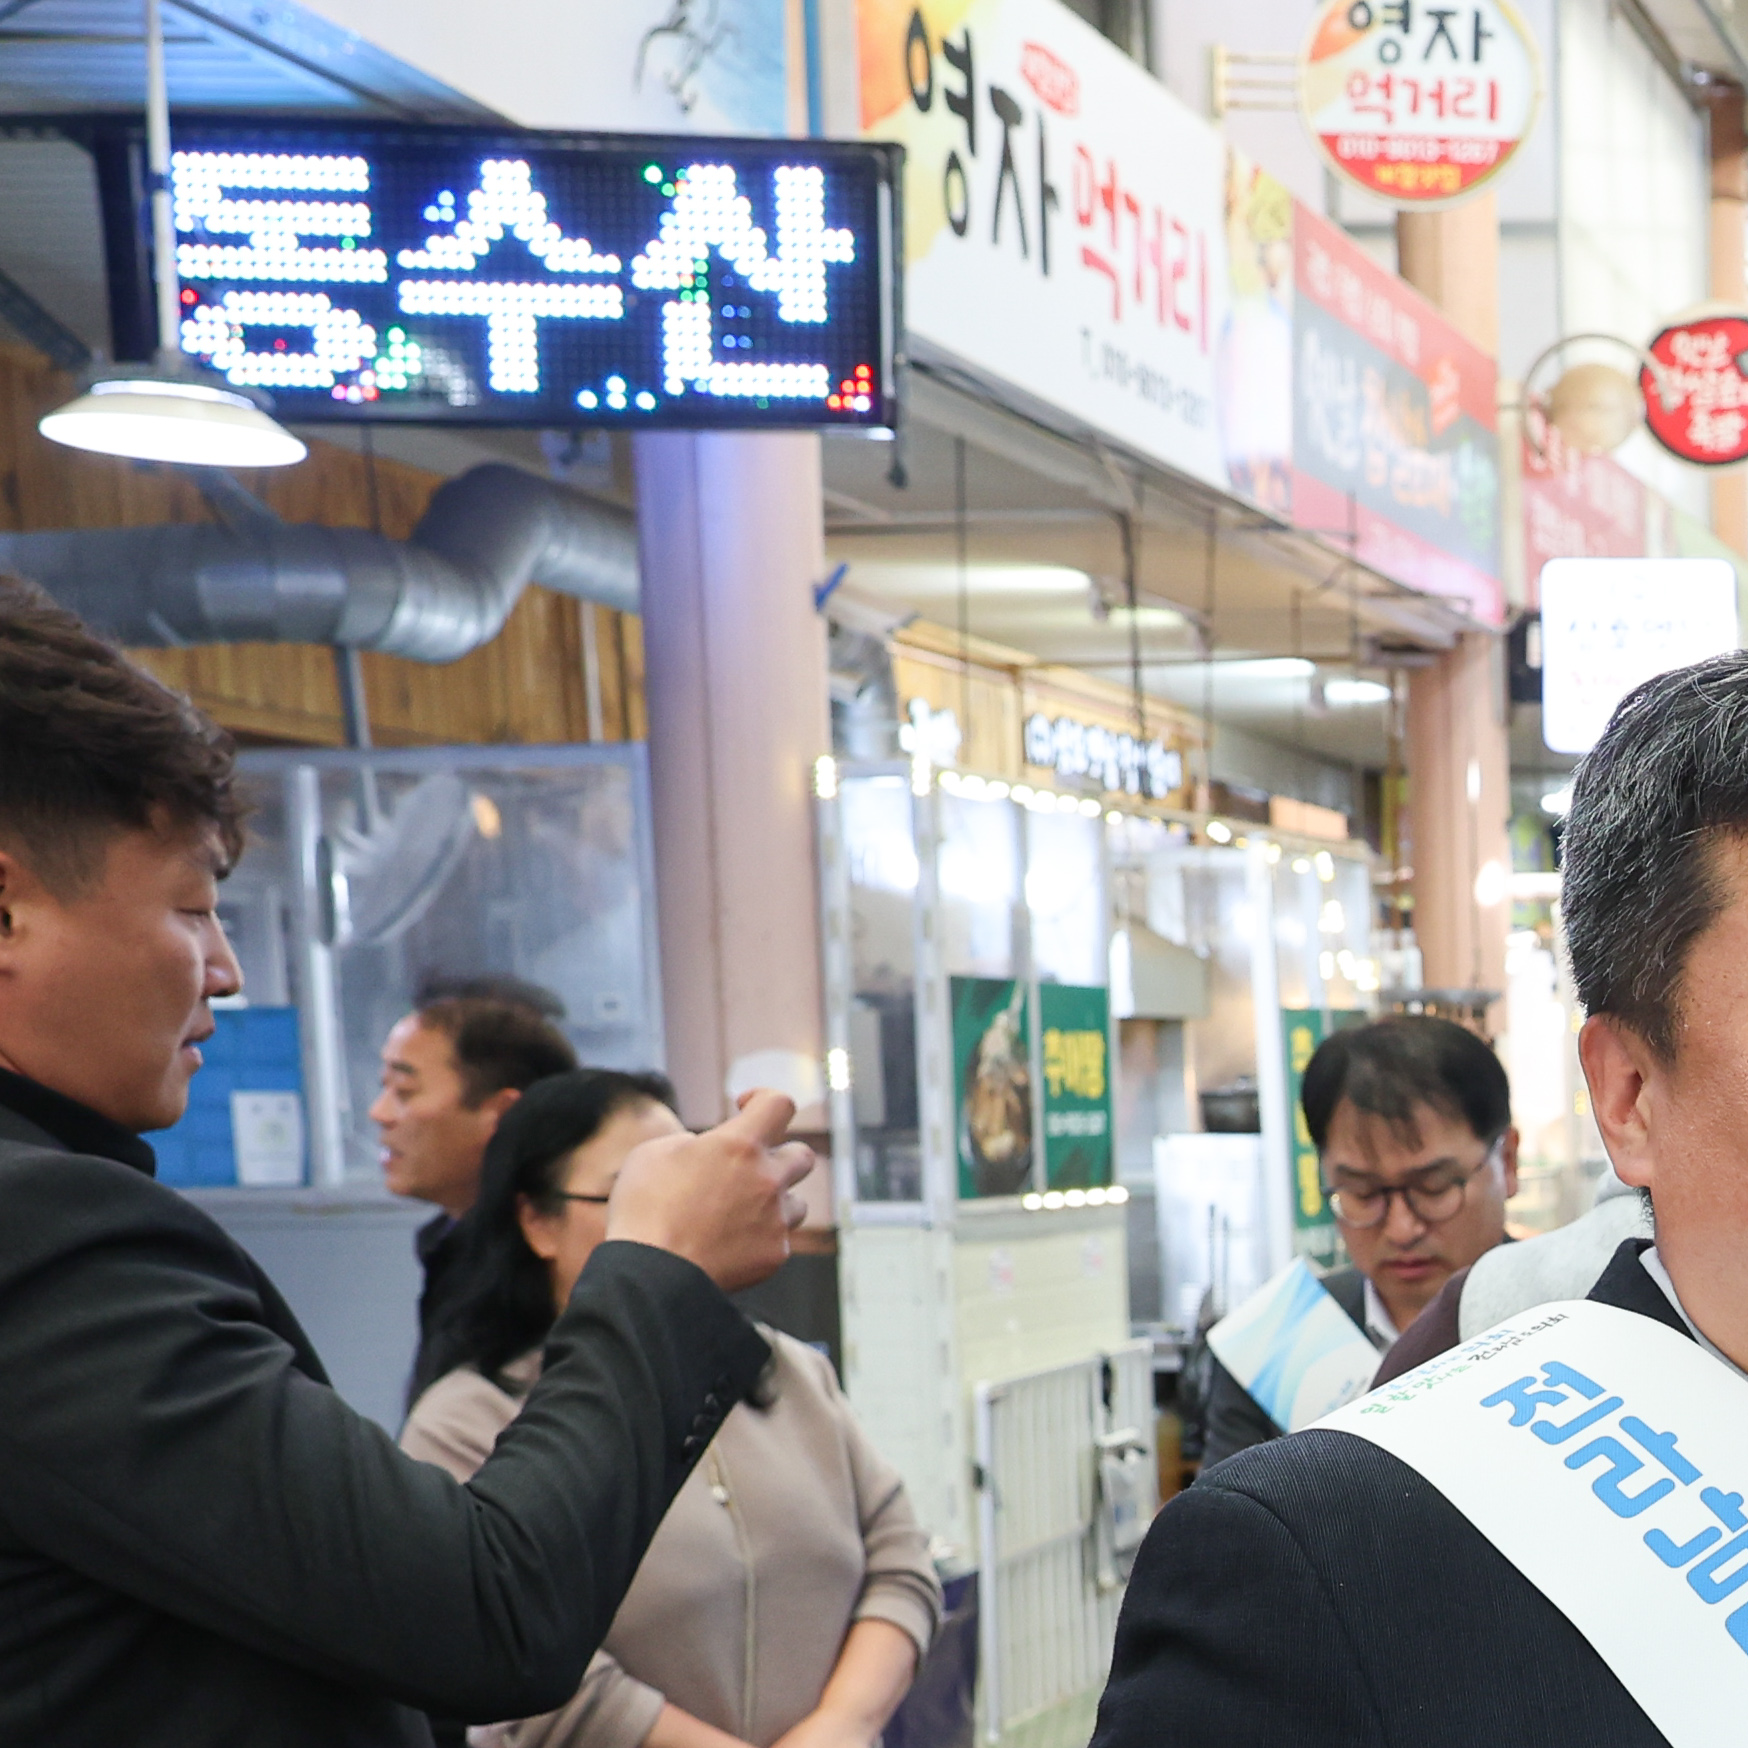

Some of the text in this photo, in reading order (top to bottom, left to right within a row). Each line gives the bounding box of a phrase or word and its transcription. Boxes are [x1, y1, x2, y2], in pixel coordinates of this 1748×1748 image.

[1350, 0, 1494, 63] 영자
[172, 152, 855, 396] 동수산
[905, 8, 1060, 276] 영자
[1074, 144, 1209, 353] 먹거리
